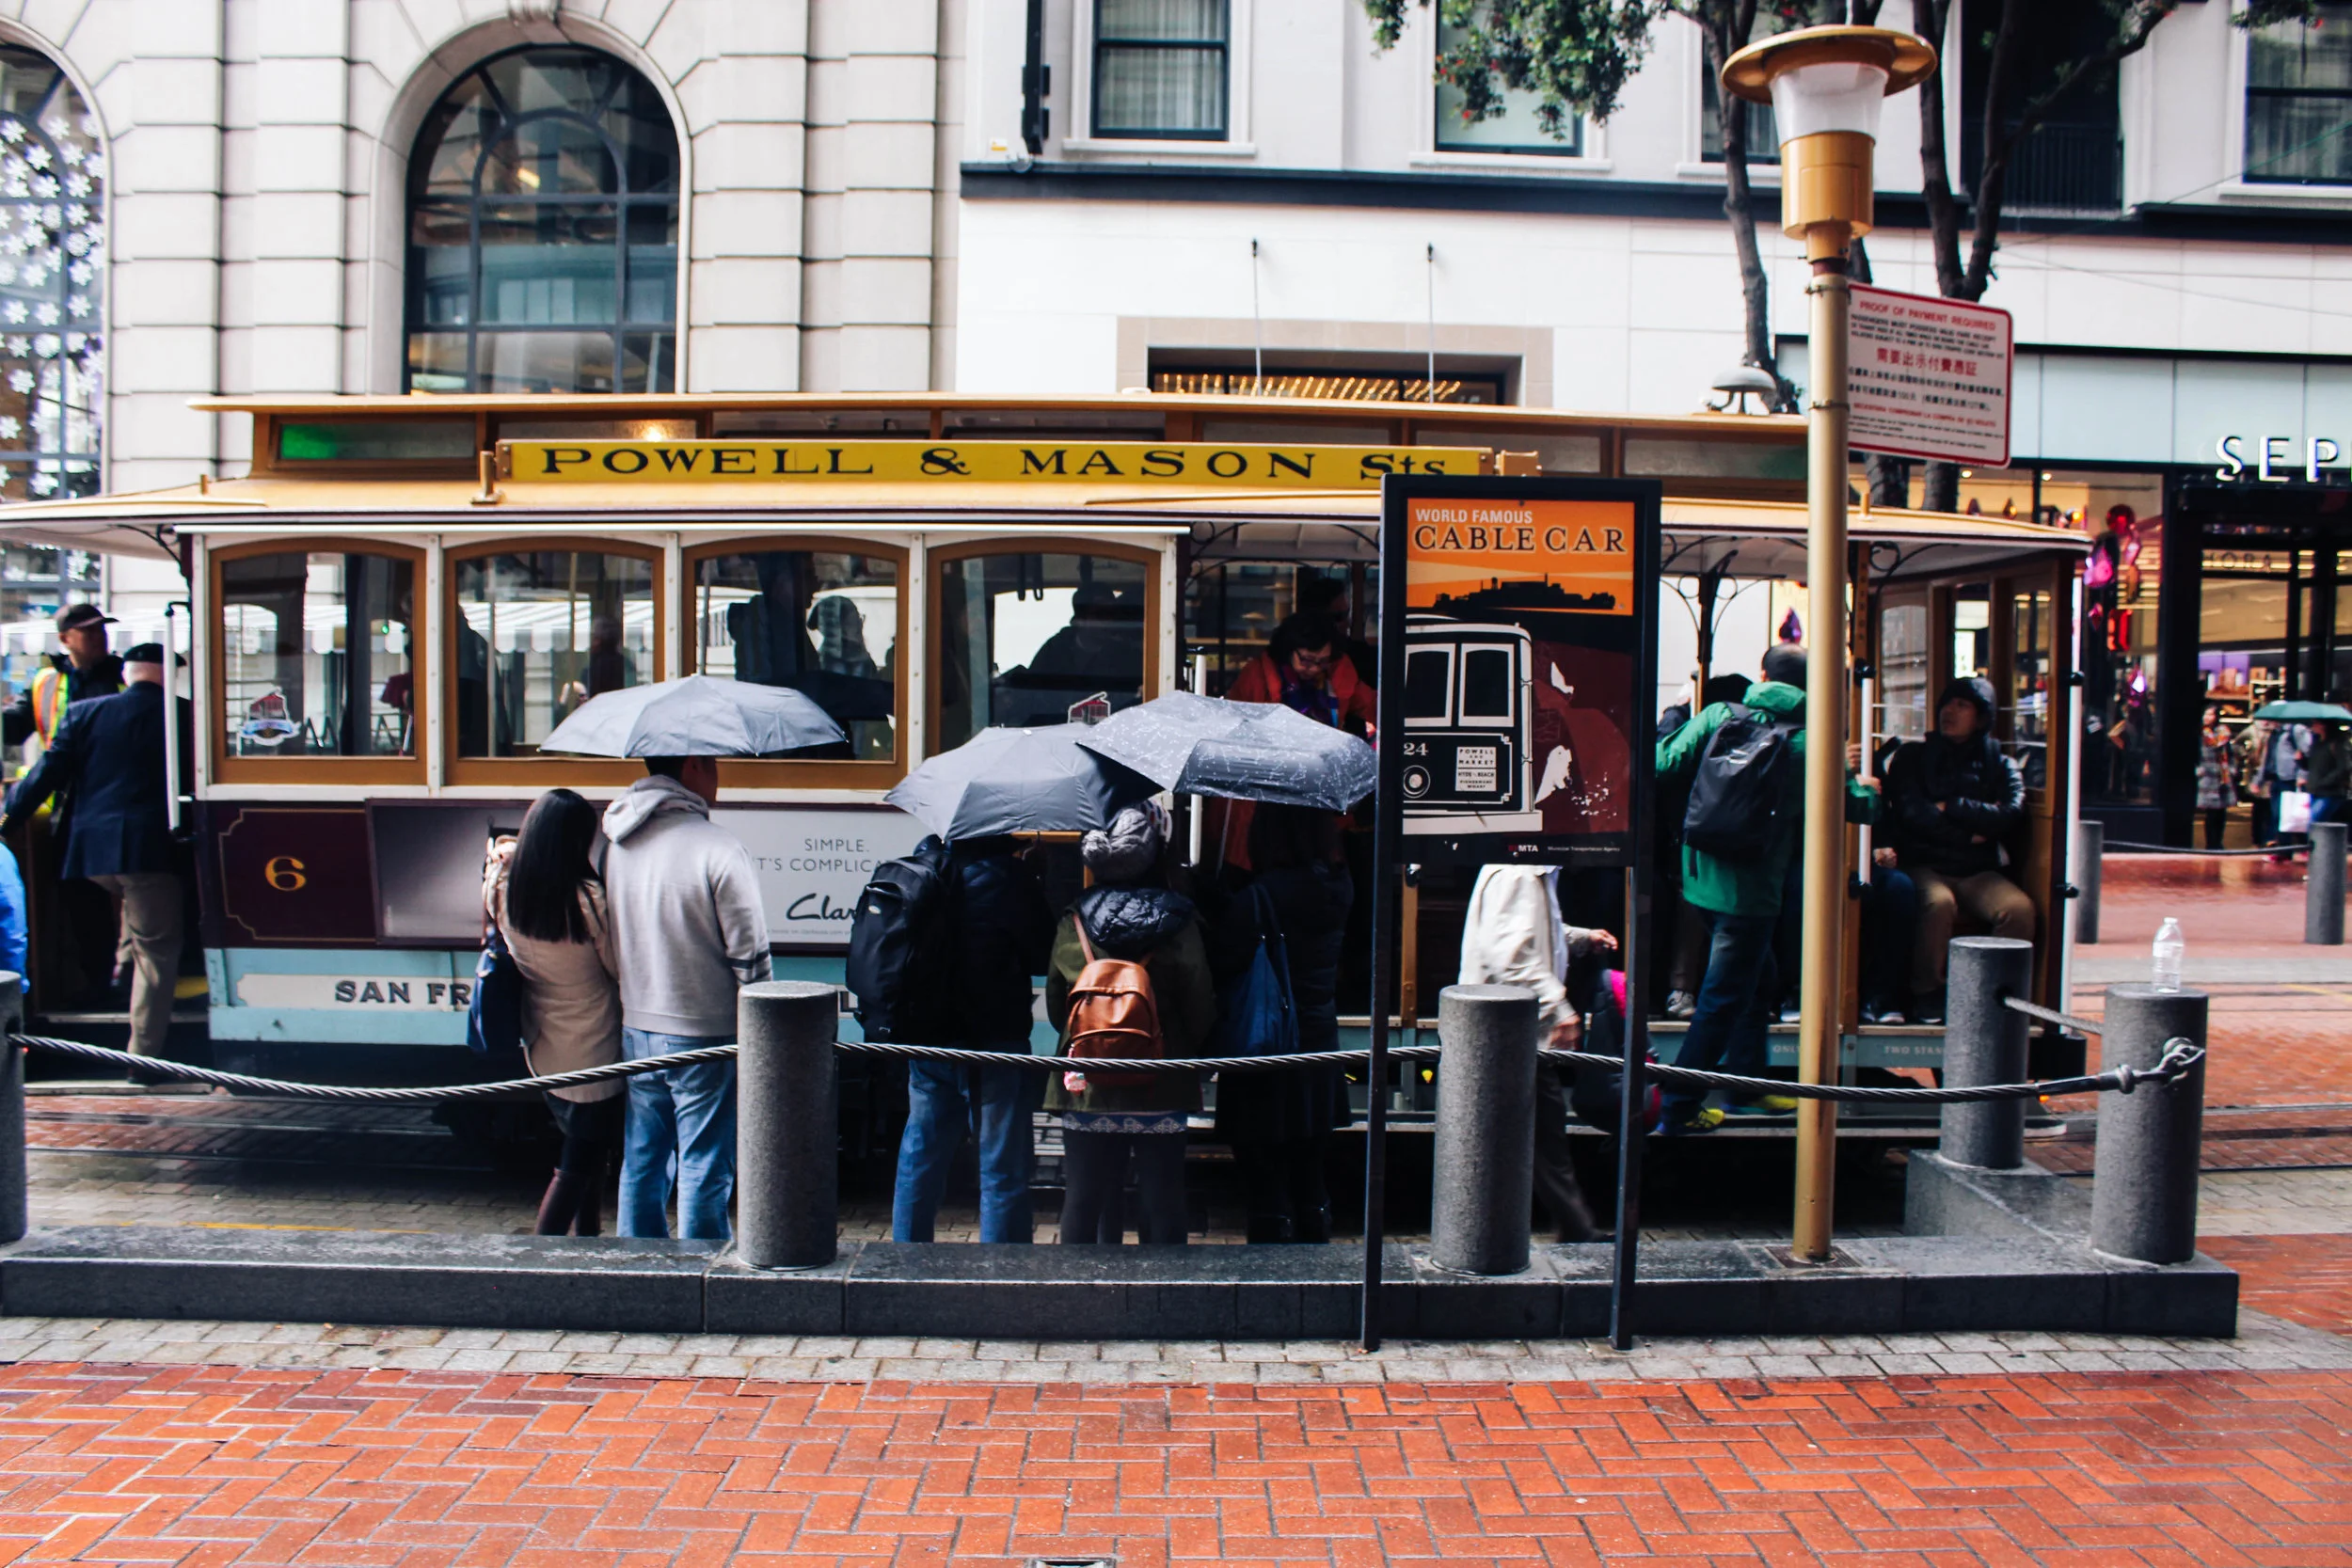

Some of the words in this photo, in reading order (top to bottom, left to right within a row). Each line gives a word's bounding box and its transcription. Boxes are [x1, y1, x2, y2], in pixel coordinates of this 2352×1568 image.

[1859, 300, 1889, 313] PROOF
[1893, 306, 1905, 316] OF
[1909, 309, 1948, 323] PAYMENT
[1951, 315, 1996, 331] REQUIRED
[541, 448, 874, 475] POWELL
[919, 447, 971, 476] &
[1019, 449, 1314, 480] MASON
[1360, 453, 1445, 481] Sts
[2216, 436, 2352, 483] SEP
[1415, 509, 1468, 523] WORLD
[1472, 510, 1533, 524] FAMOUS
[1413, 524, 1535, 551] CABLE
[1544, 526, 1627, 553] CAR
[1403, 742, 1429, 756] 24
[804, 838, 869, 852] SIMPLE.
[264, 856, 307, 892] 6
[752, 857, 783, 871] T'S
[789, 858, 889, 873] COMPLICA
[787, 893, 857, 921] Clar
[335, 980, 411, 1004] SAN
[427, 983, 471, 1006] FR
[1914, 1046, 1944, 1054] STAN
